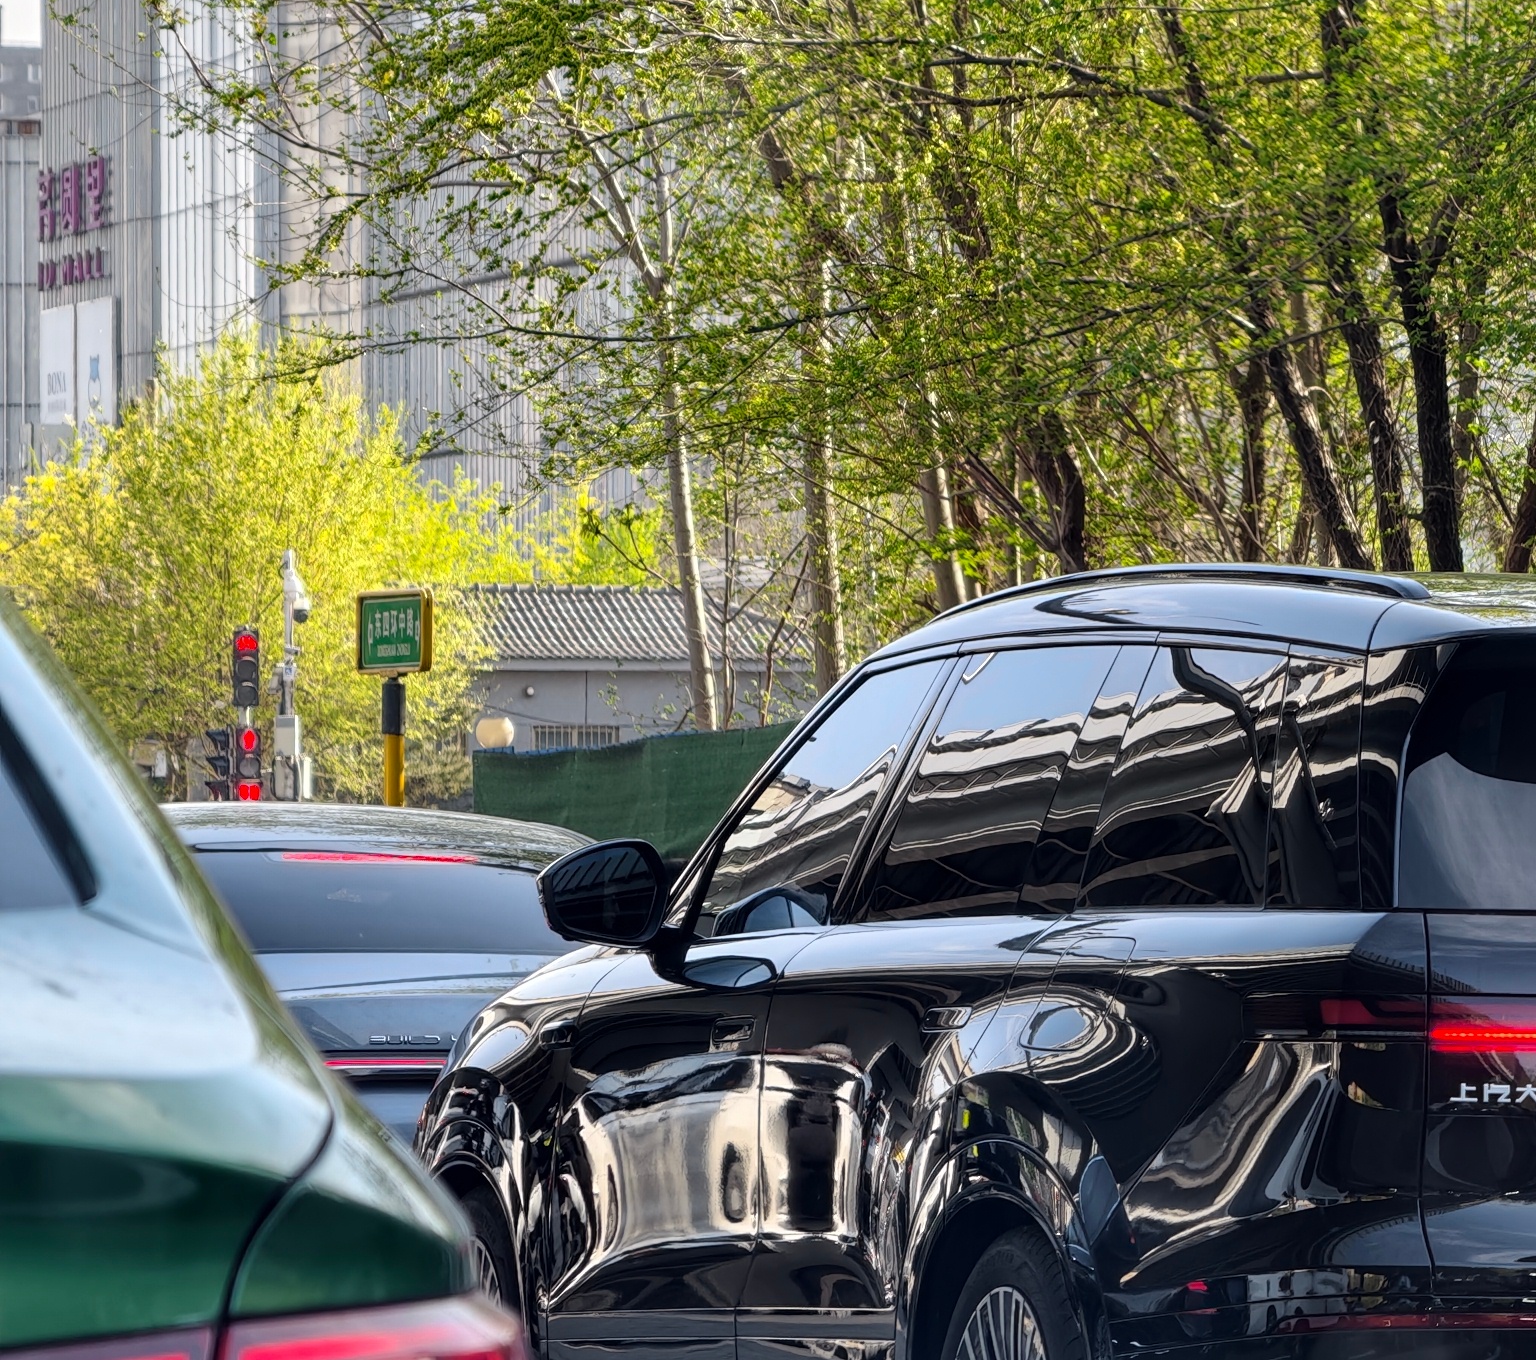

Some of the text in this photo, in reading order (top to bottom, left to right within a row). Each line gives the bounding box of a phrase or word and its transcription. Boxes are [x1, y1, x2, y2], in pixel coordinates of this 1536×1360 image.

[374, 607, 414, 639] 东四环中路
[369, 1035, 441, 1045] BUILD
